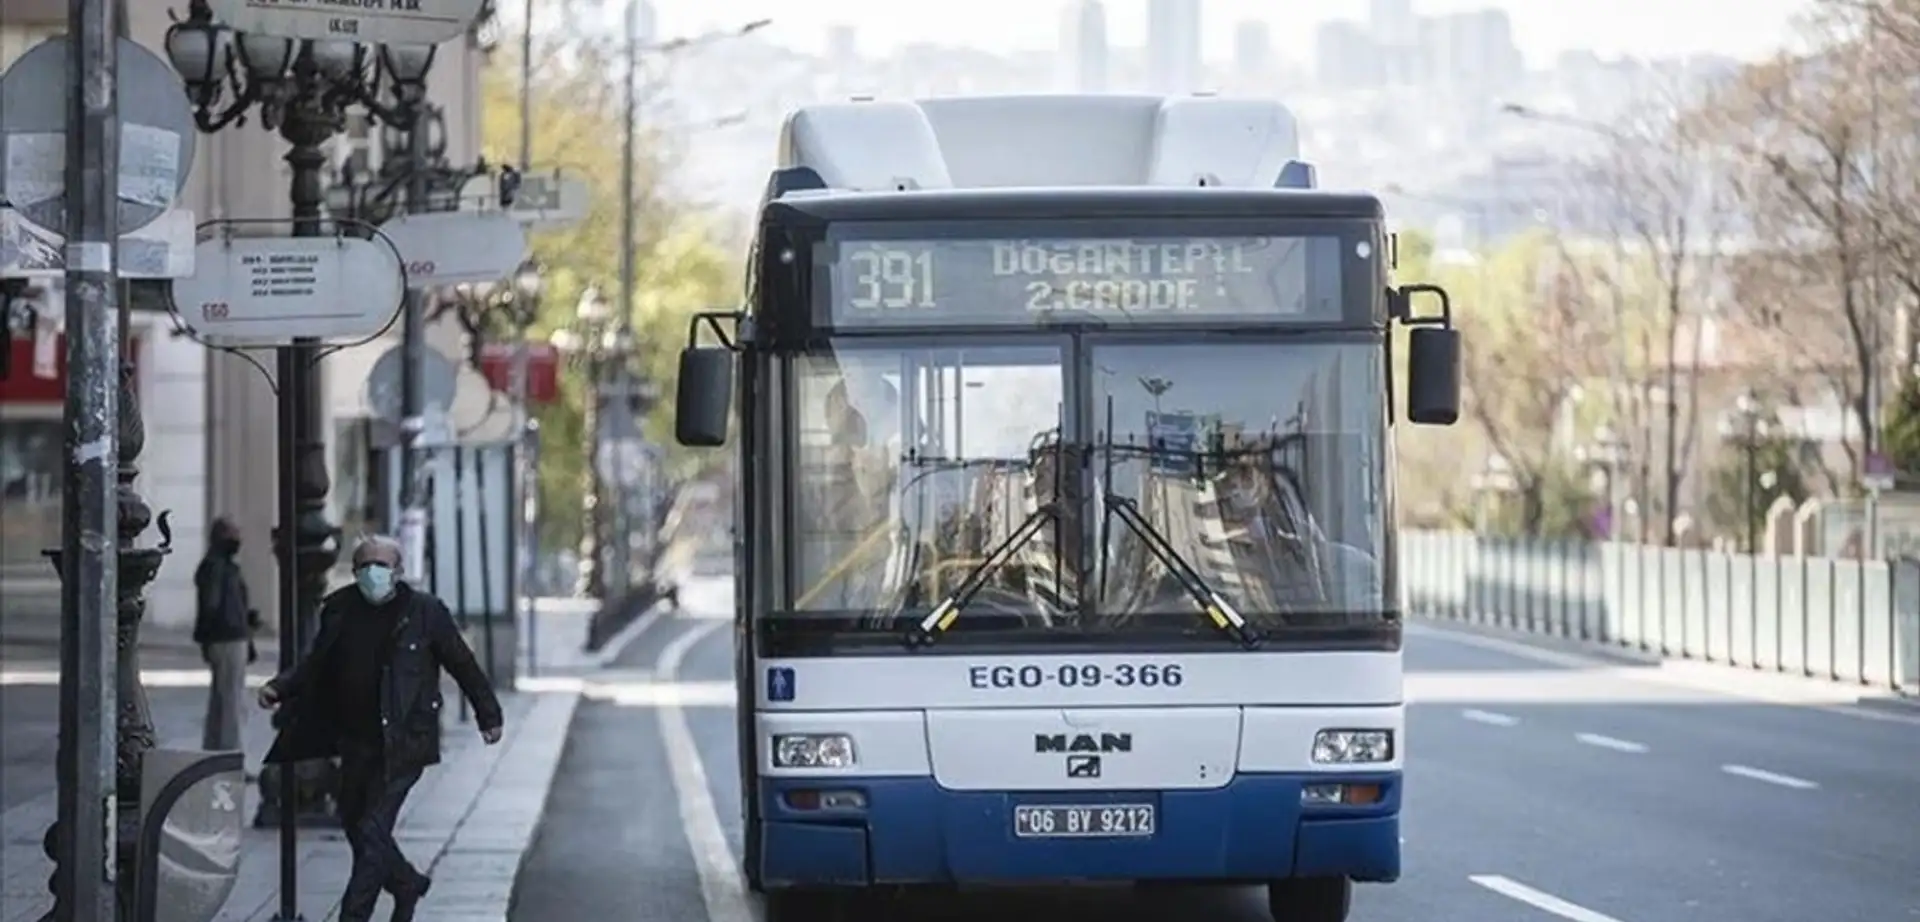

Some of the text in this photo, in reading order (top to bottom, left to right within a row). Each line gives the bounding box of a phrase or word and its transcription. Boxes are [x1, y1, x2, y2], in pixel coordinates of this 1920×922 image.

[403, 260, 435, 274] GO
[851, 250, 936, 308] 391
[969, 664, 1182, 688] EGO-09-366
[1035, 733, 1132, 752] MAN
[1030, 810, 1054, 832] 06
[1101, 808, 1149, 832] 9212
